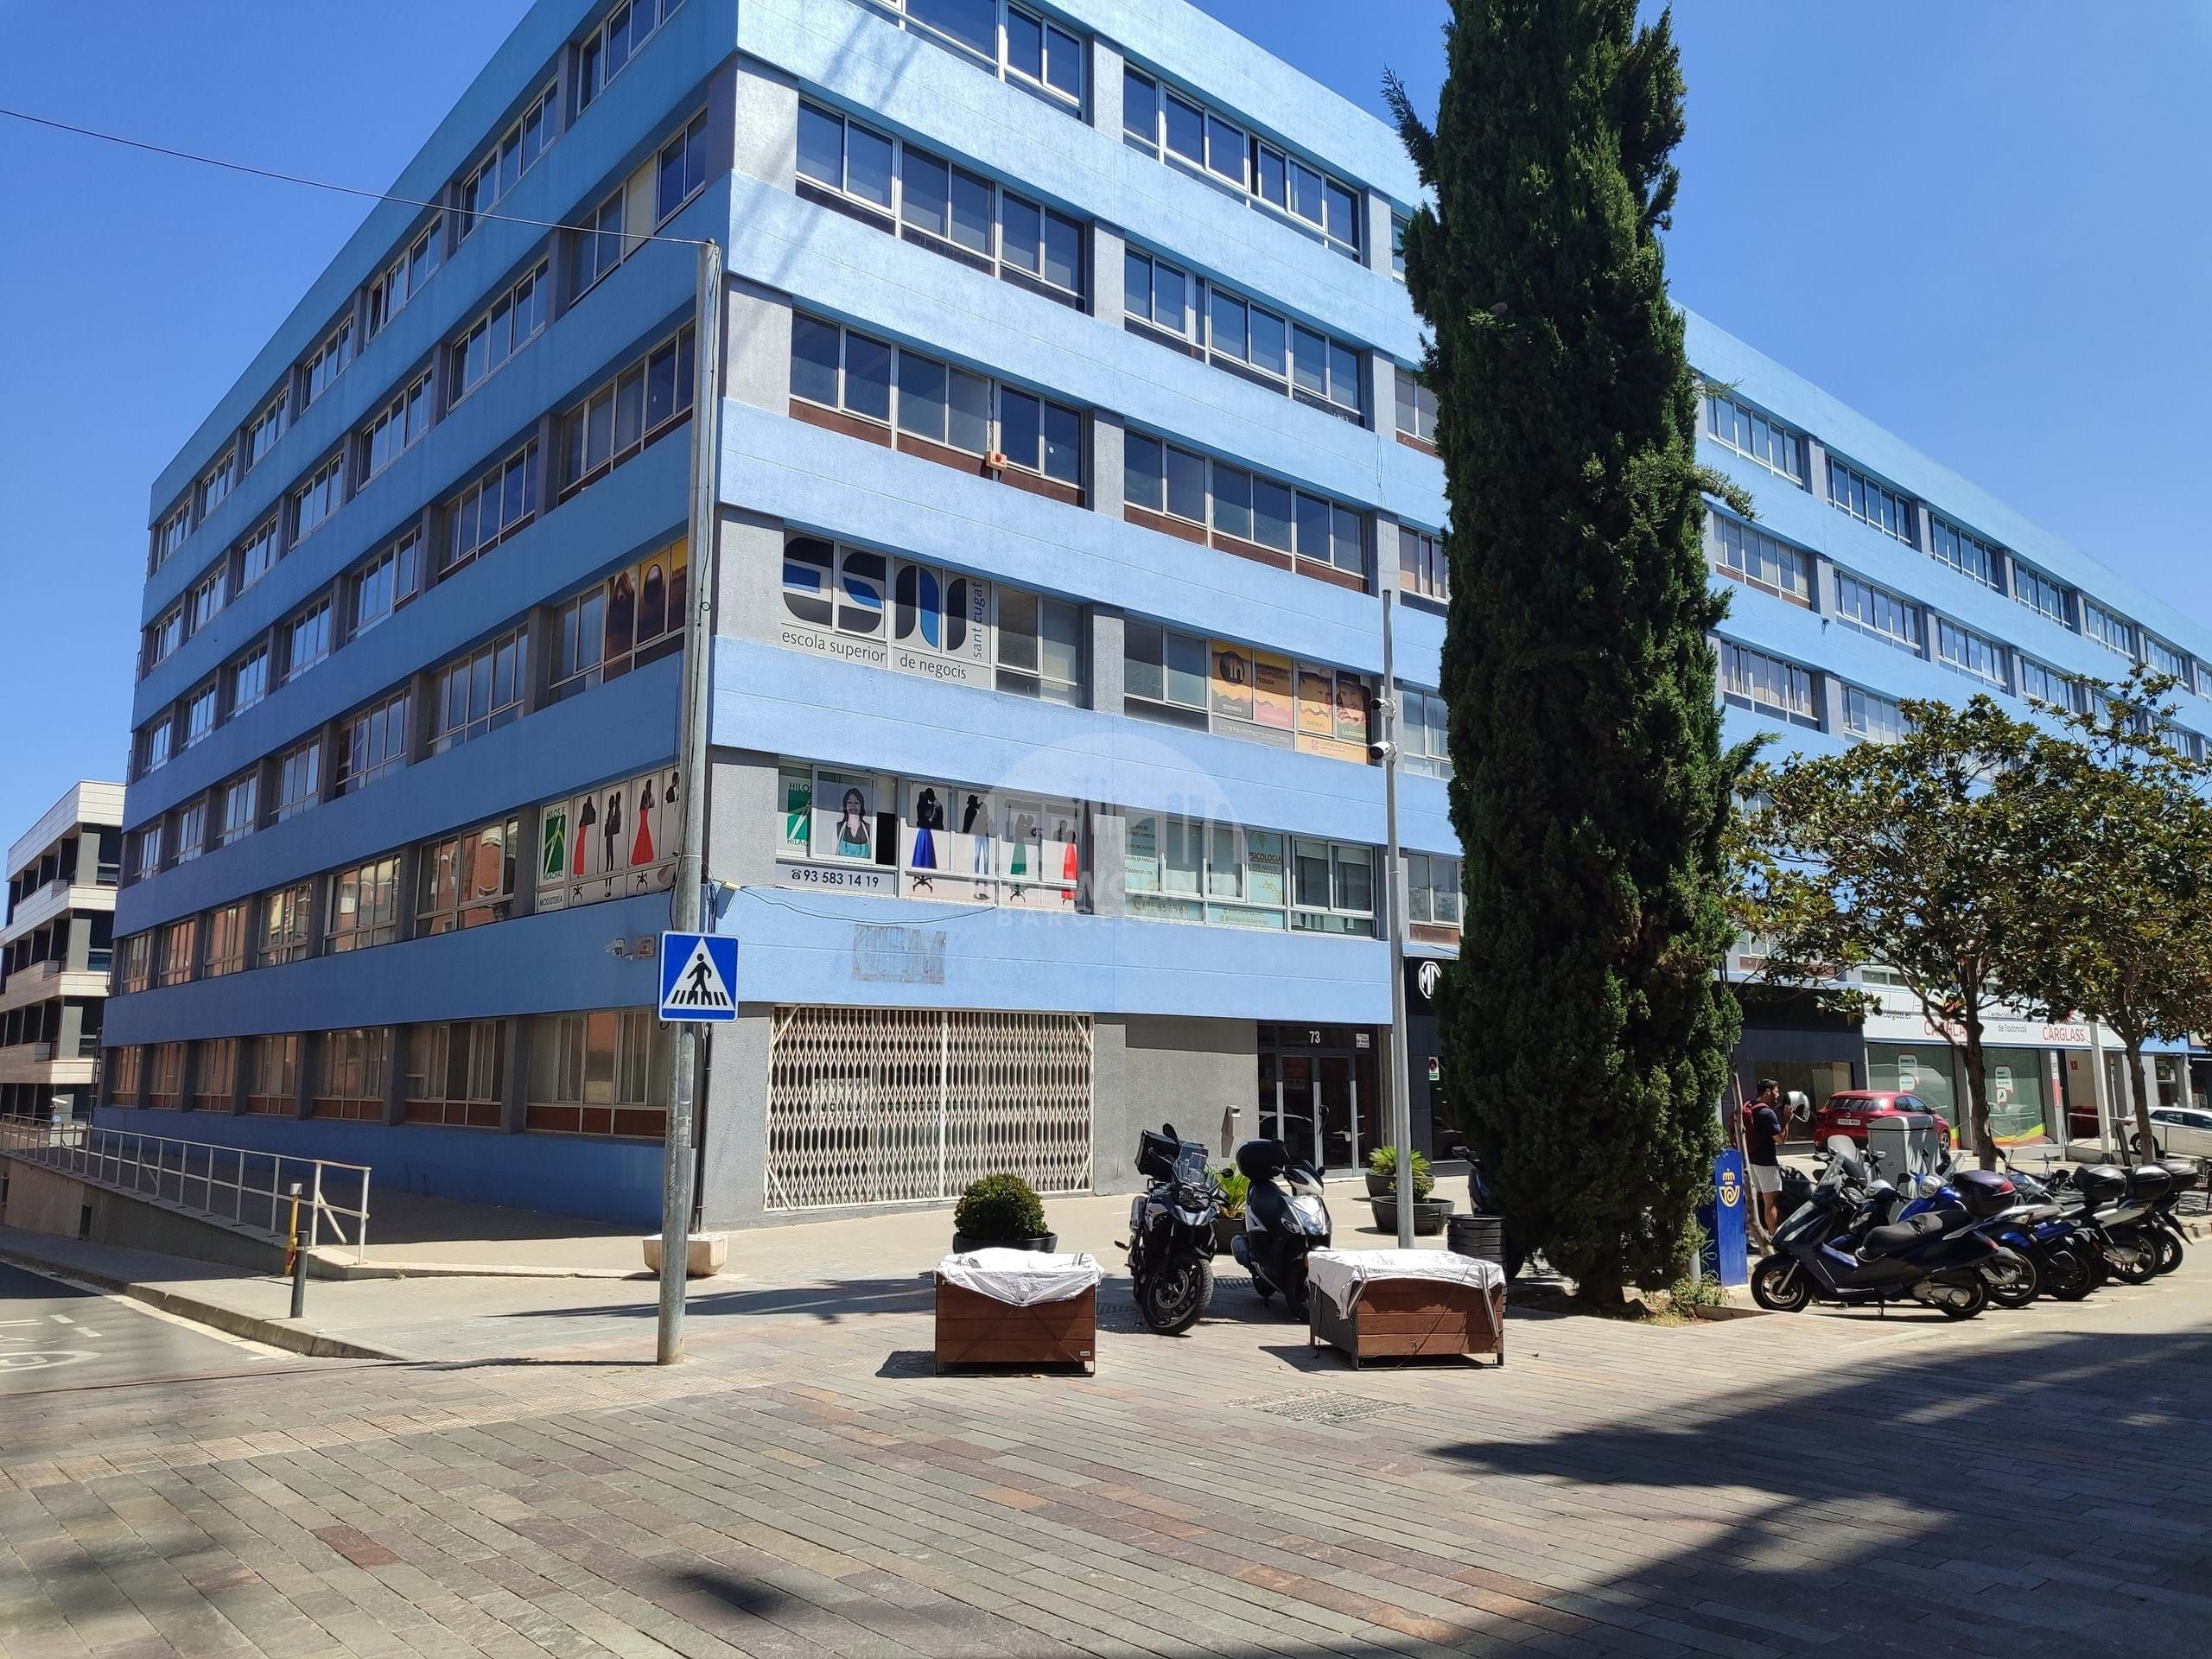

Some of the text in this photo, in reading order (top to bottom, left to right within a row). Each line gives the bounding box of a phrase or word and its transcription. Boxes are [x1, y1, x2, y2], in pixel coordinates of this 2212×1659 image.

[972, 581, 989, 658] sant cugat
[782, 629, 967, 679] escola superior de negocis
[1257, 675, 1274, 686] House
[790, 782, 812, 793] HILO
[804, 869, 880, 888] 93 583 14 19
[1309, 1030, 1321, 1044] 73
[2042, 1026, 2085, 1042] CARGLASS
